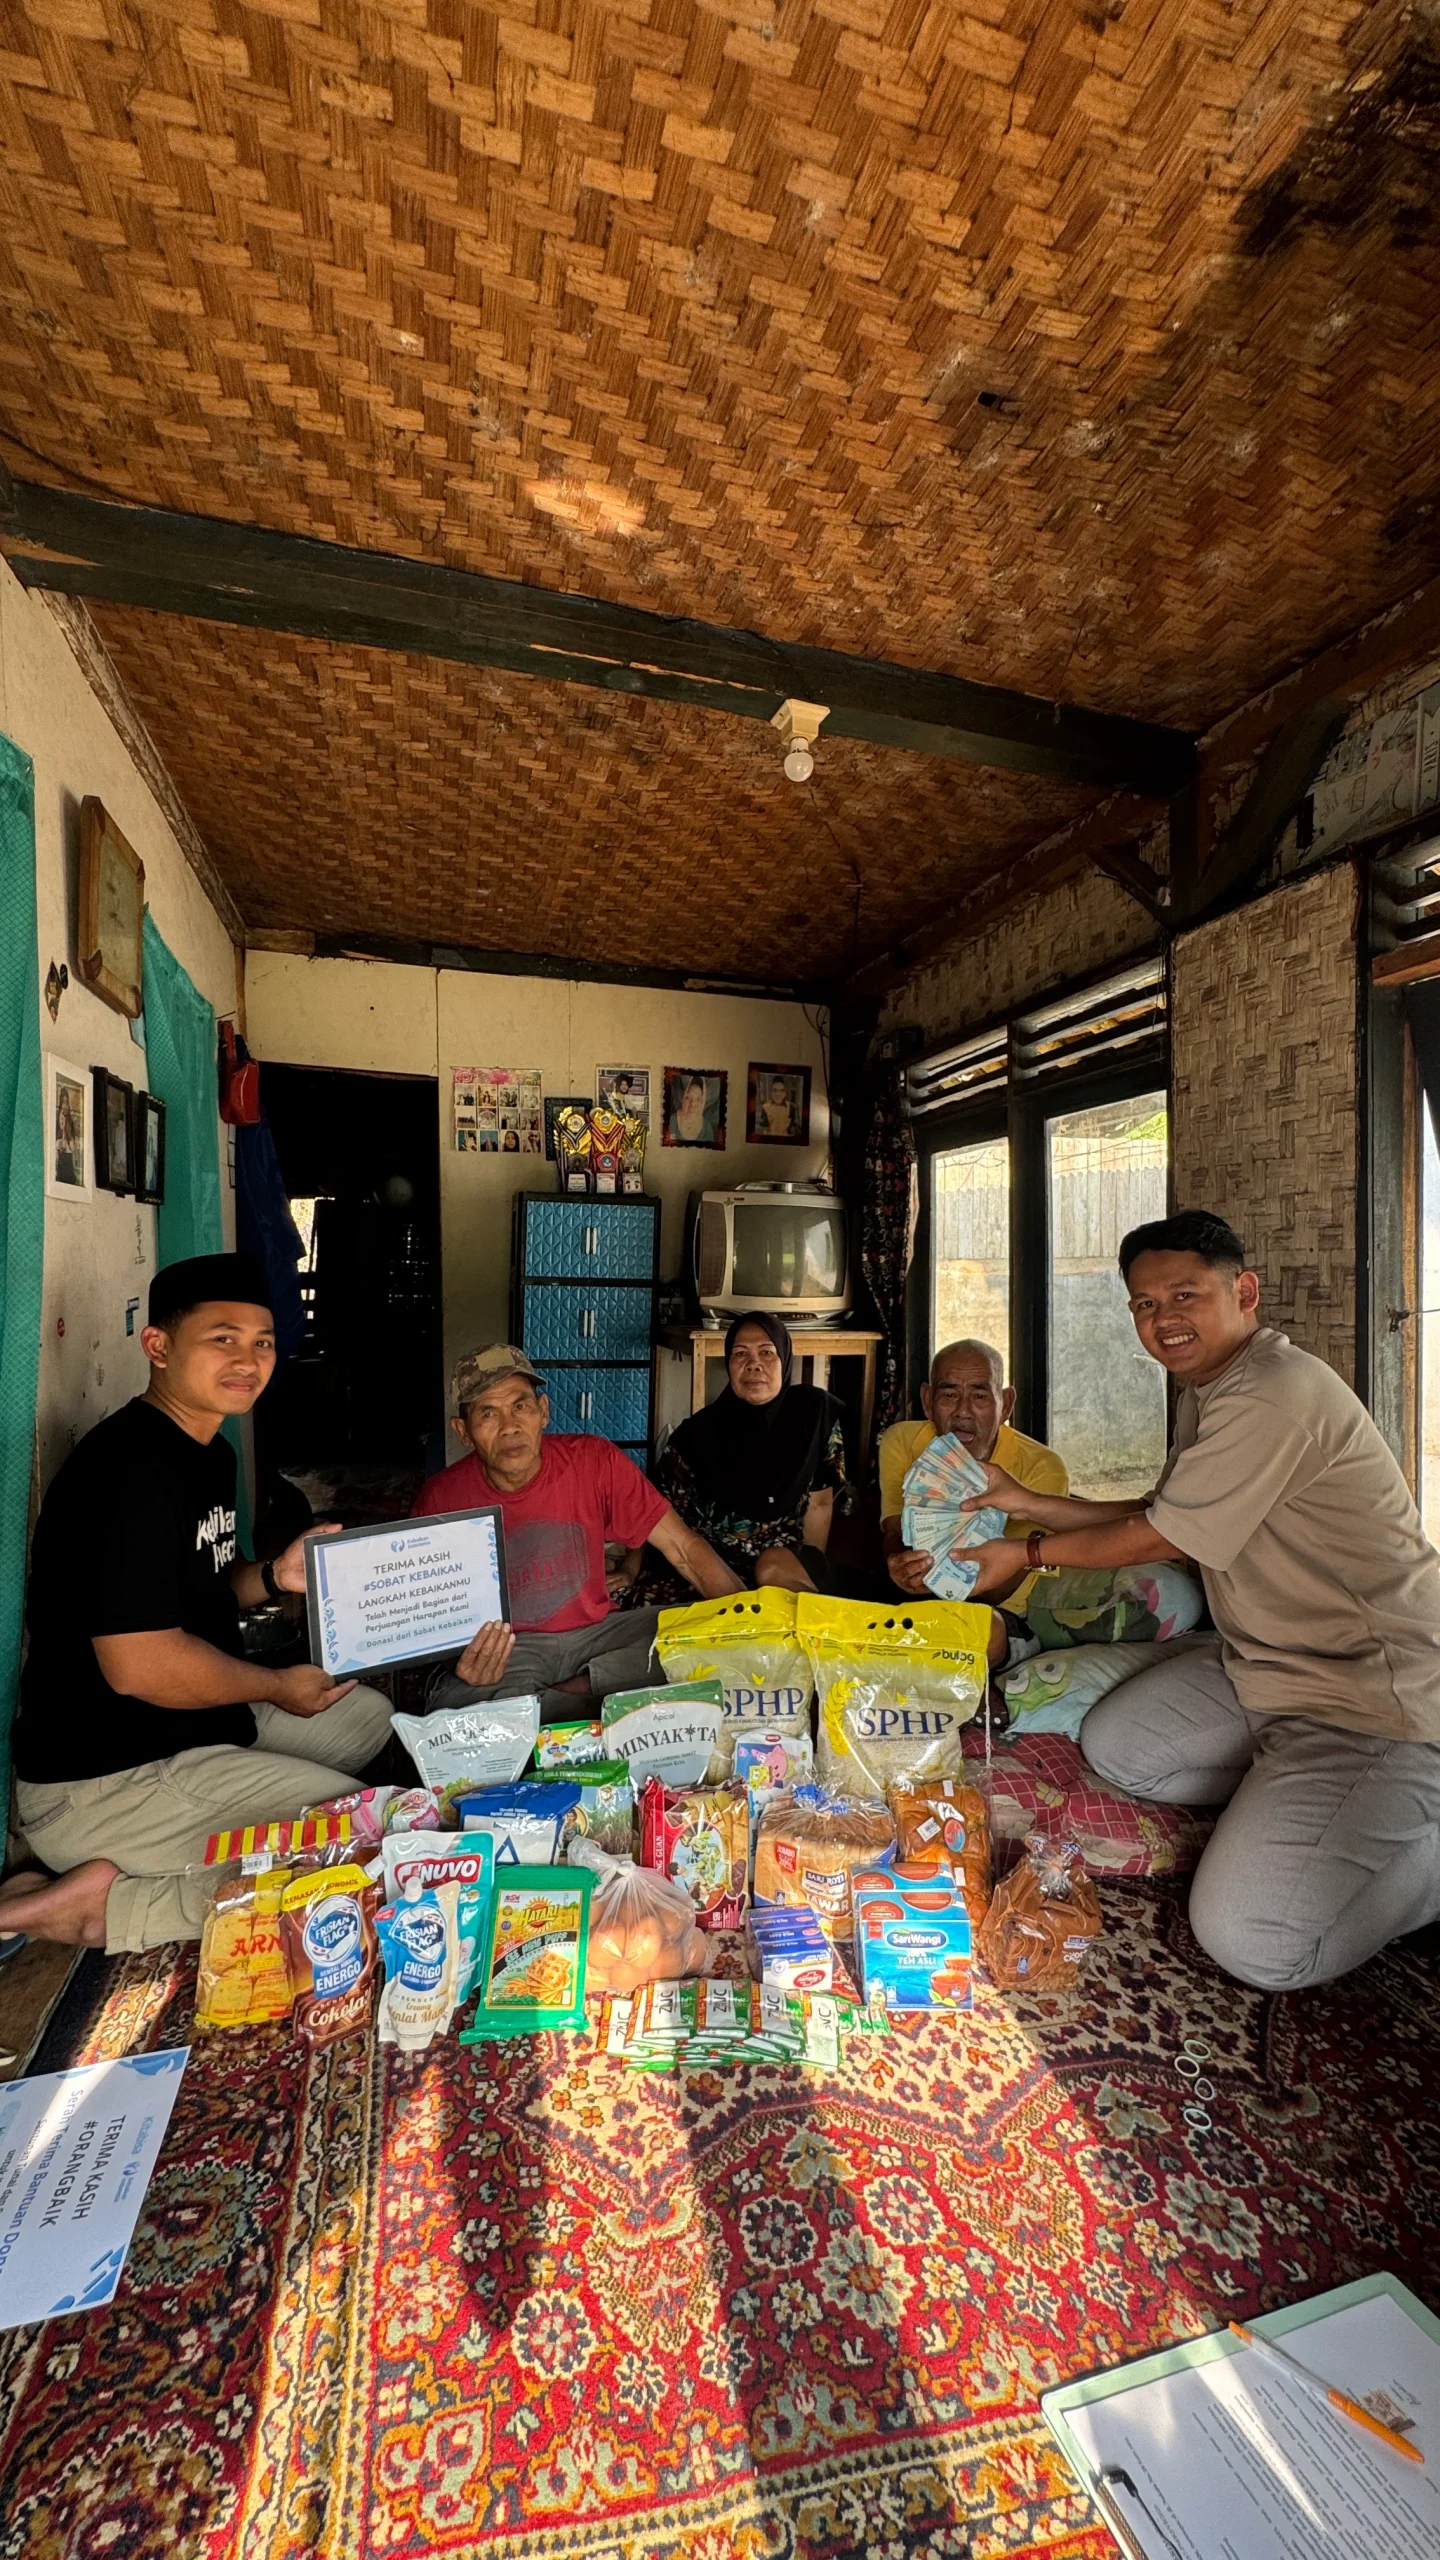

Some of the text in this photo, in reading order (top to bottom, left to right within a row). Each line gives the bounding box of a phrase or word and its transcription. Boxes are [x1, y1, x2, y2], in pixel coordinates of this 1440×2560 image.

[364, 1563, 463, 1592] #SOBAT KEBAIKAN
[374, 1551, 451, 1575] TERIMA KASIH
[358, 1577, 471, 1609] LANGKAH KEBAIKANMU
[365, 1592, 468, 1622] Telah Menjadi Bagian dari
[365, 1602, 470, 1633] Perjuangan Harapan Kami
[366, 1617, 473, 1648] Donasi dari Sobat Kebaikan
[653, 1713, 676, 1722] Apical
[858, 1707, 954, 1736] SPHP
[656, 1835, 664, 1857] GUAN
[420, 1859, 478, 1883] NUVO
[807, 1872, 845, 1886] SARI ROTI
[284, 1887, 320, 1905] KEMASAN
[315, 1915, 350, 1941] FRISIAN
[519, 1904, 560, 1927] HATARI
[892, 1933, 941, 1946] SariWangi
[403, 1961, 441, 1979] ENERGO
[897, 1956, 937, 1965] TEH ASLI
[316, 1960, 361, 1992] ENERGO
[406, 2003, 432, 2011] Creamy
[59, 2089, 84, 2125] Serah
[20, 2118, 47, 2162] Santunan
[39, 2125, 70, 2170] Terima
[132, 2115, 155, 2156] Kitabisa
[38, 2120, 99, 2230] #ORANGBAIK
[71, 2115, 126, 2220] TERIMA KASIH
[9, 2171, 48, 2229] Bantuan
